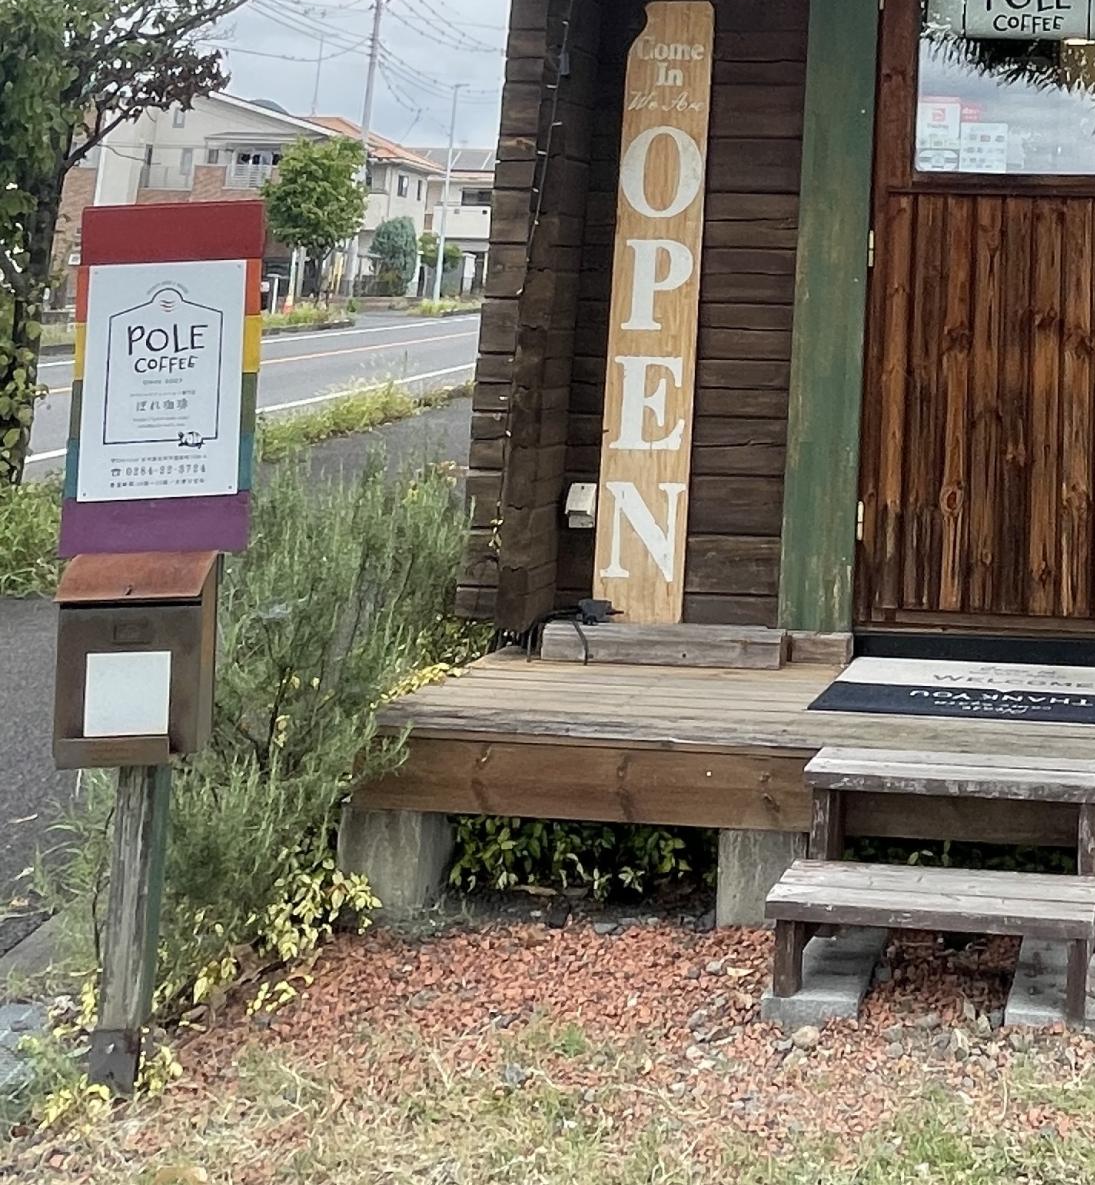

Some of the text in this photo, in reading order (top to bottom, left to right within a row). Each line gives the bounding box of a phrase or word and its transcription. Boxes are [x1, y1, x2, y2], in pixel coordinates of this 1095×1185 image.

[992, 14, 1065, 34] COFFEE
[639, 35, 705, 61] Come
[655, 62, 684, 86] In
[127, 323, 209, 356] POLE
[134, 355, 199, 374] COFFEE
[599, 125, 705, 583] OPEN
[933, 674, 1094, 689] WELCOME
[909, 690, 1095, 707] THANK YOU
